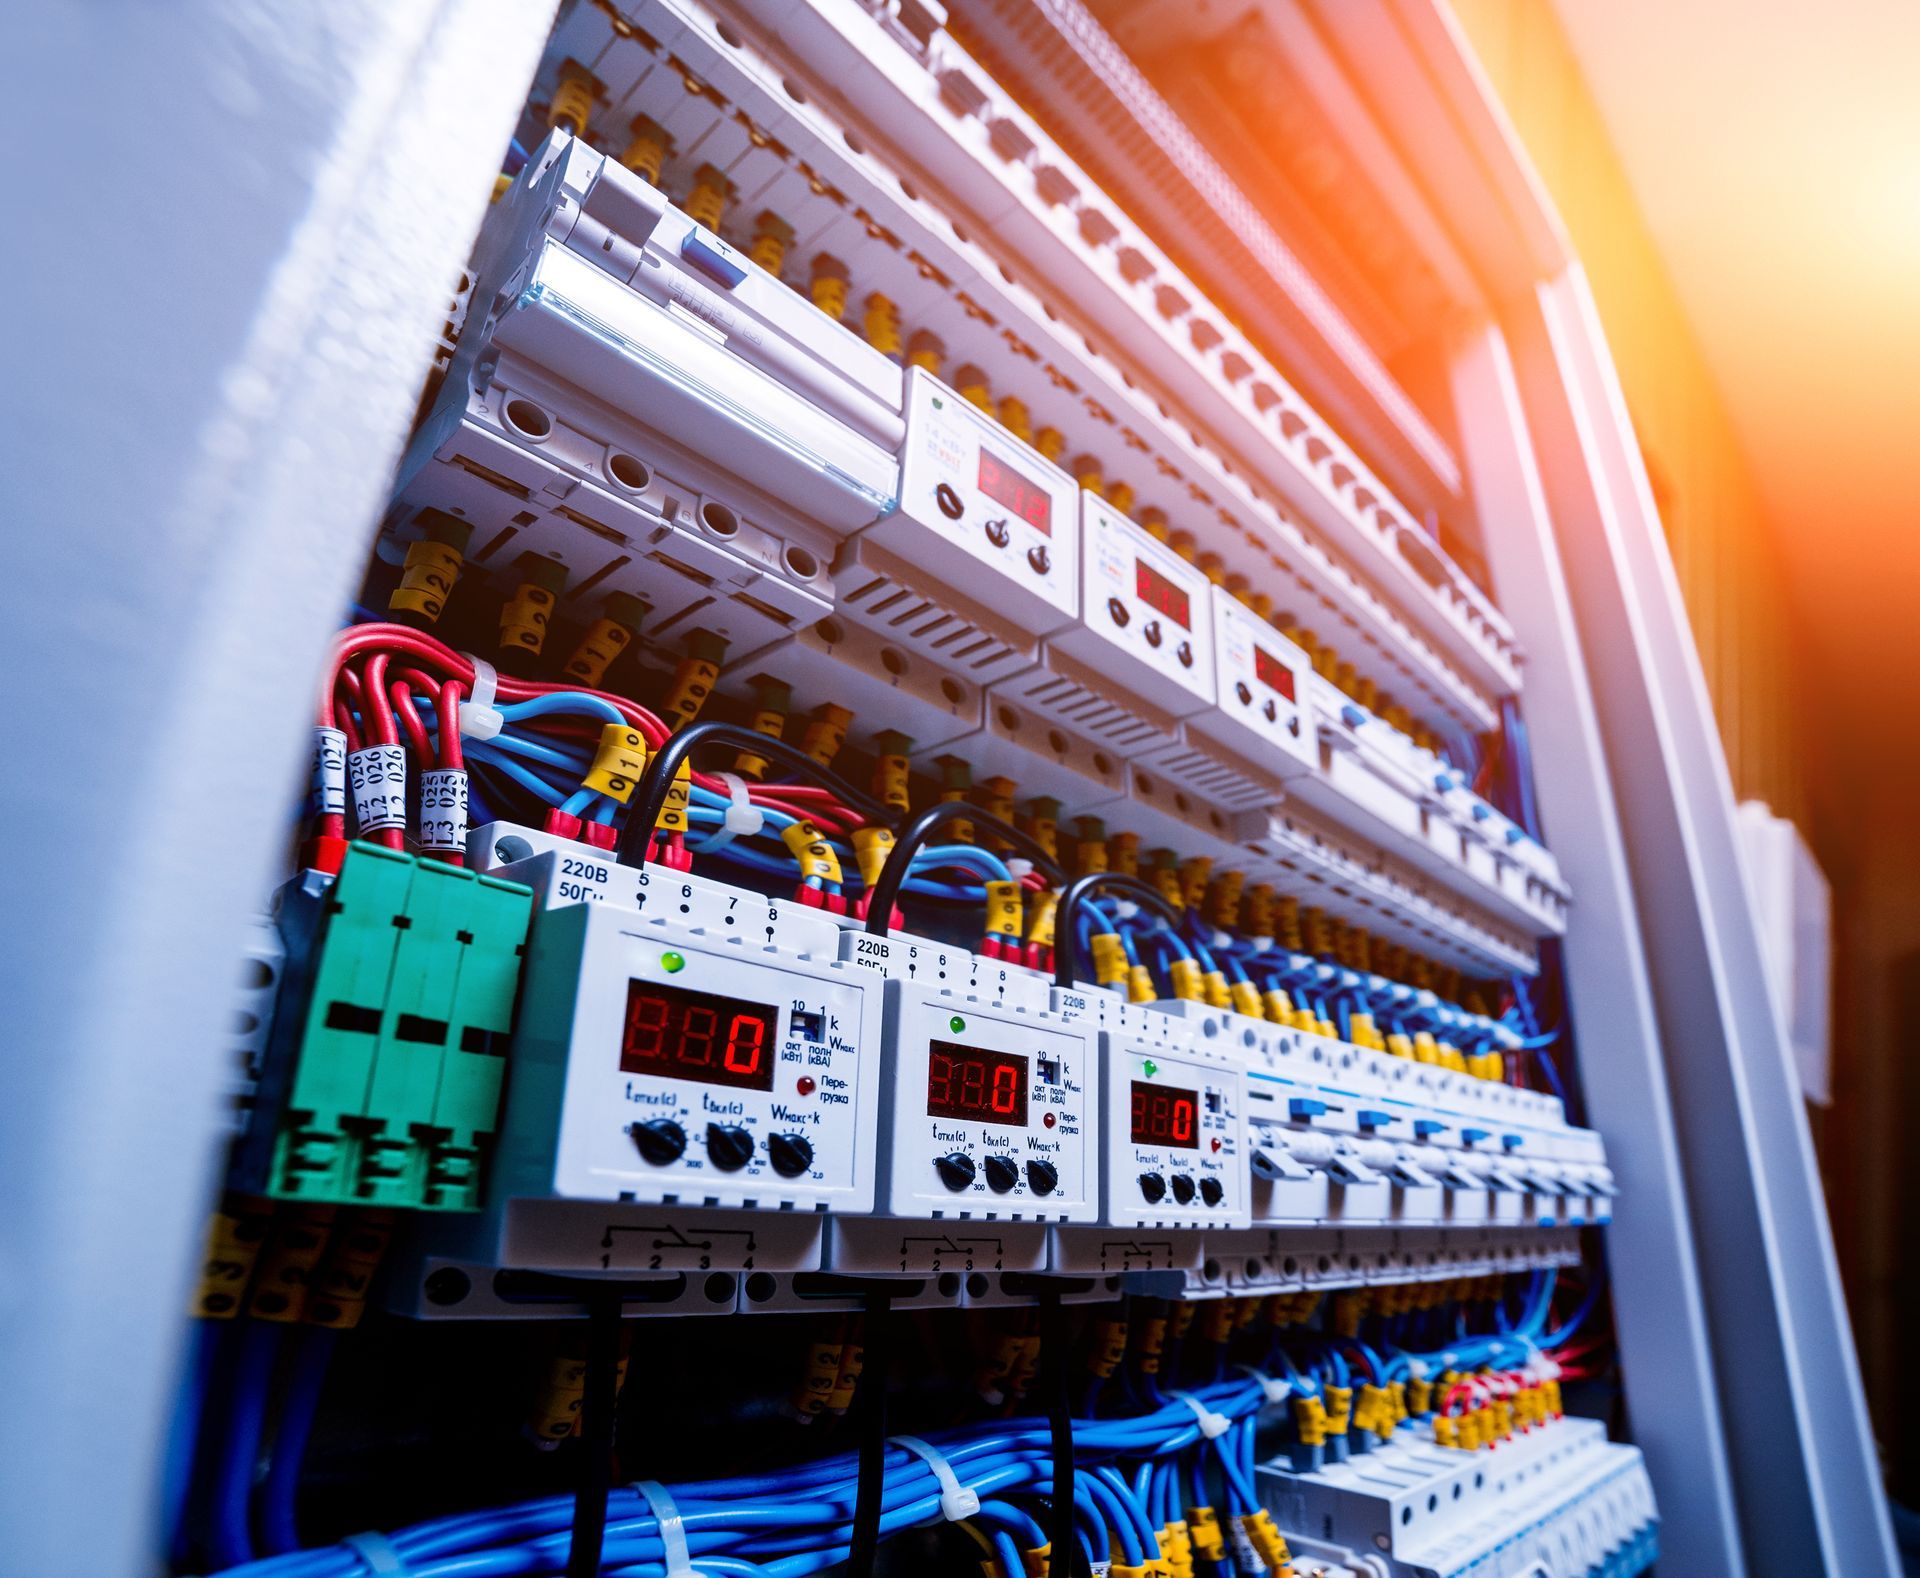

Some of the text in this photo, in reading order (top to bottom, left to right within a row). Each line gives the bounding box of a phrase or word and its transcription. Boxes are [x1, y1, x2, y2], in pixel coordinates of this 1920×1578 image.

[322, 735, 344, 771] 027
[608, 734, 640, 791] 010
[351, 755, 365, 790] 026
[384, 750, 403, 783] 026
[365, 751, 390, 820] L2 026
[425, 775, 439, 809] 025
[436, 775, 457, 845] L3 025
[561, 858, 609, 884] 220В
[558, 881, 604, 901] 50Г
[638, 873, 778, 921] 5 6 7 8
[857, 939, 890, 958] 220В
[909, 947, 1006, 982] 5 6 7 8
[792, 999, 826, 1016] 10 1
[781, 1049, 802, 1064] (кВт)
[785, 1041, 832, 1057] акт полн
[1037, 1051, 1061, 1063] 10 1
[821, 1075, 849, 1090] Пере-
[820, 1092, 849, 1105] грузка
[973, 1183, 986, 1192] 300
[601, 1254, 753, 1270] 1 2 3 4
[901, 1260, 1002, 1271] 1 2 3 4
